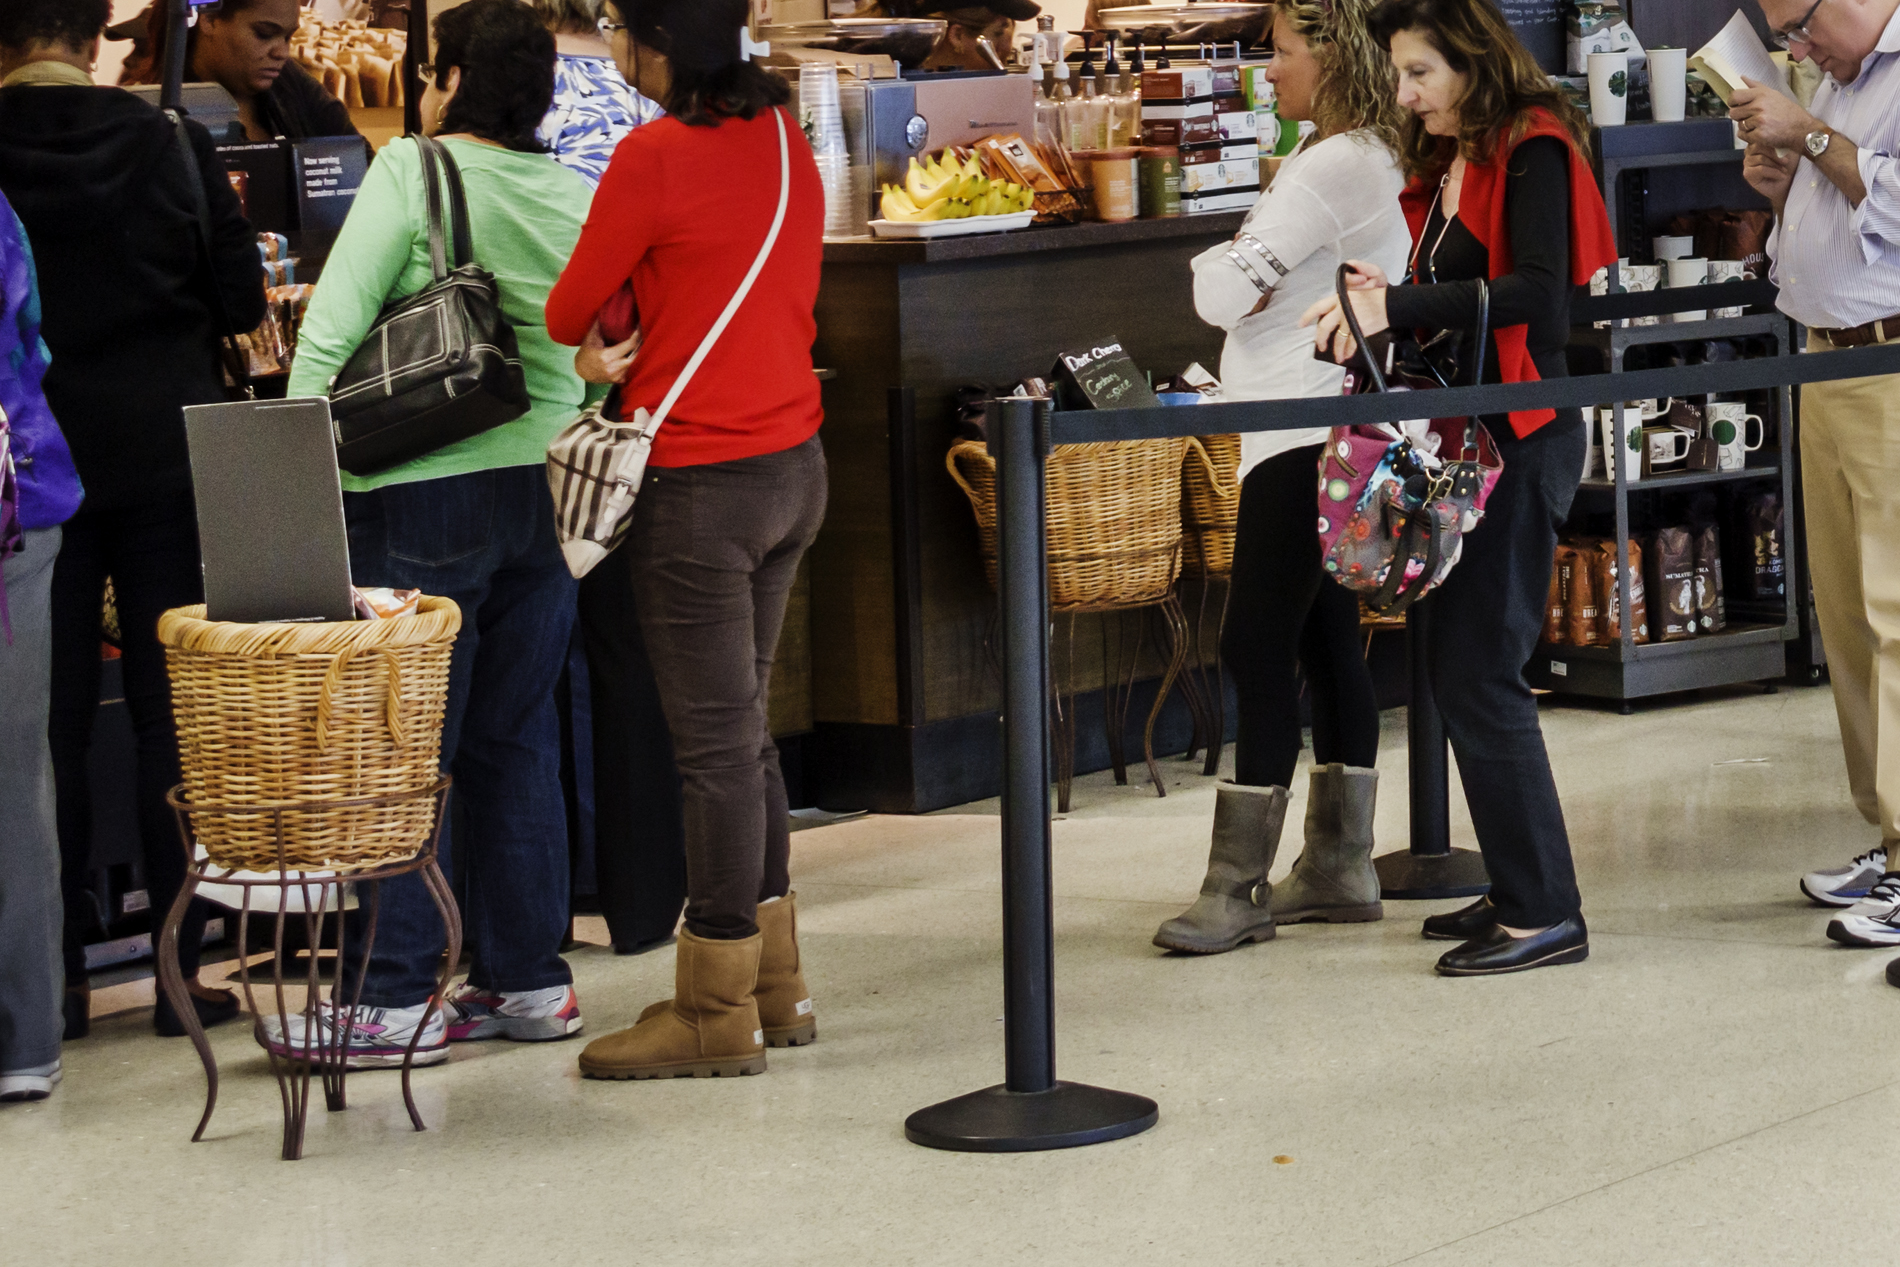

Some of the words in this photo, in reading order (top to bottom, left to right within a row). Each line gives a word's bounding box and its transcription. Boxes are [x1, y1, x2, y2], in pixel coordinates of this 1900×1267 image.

[303, 157, 318, 166] Now
[318, 155, 340, 165] serving
[305, 167, 330, 176] coconut
[329, 165, 343, 174] milk
[306, 178, 323, 187] made
[323, 177, 338, 186] from
[1064, 352, 1094, 372] Dark
[1755, 563, 1785, 575] DRAGO
[1665, 570, 1694, 580] SUMATR
